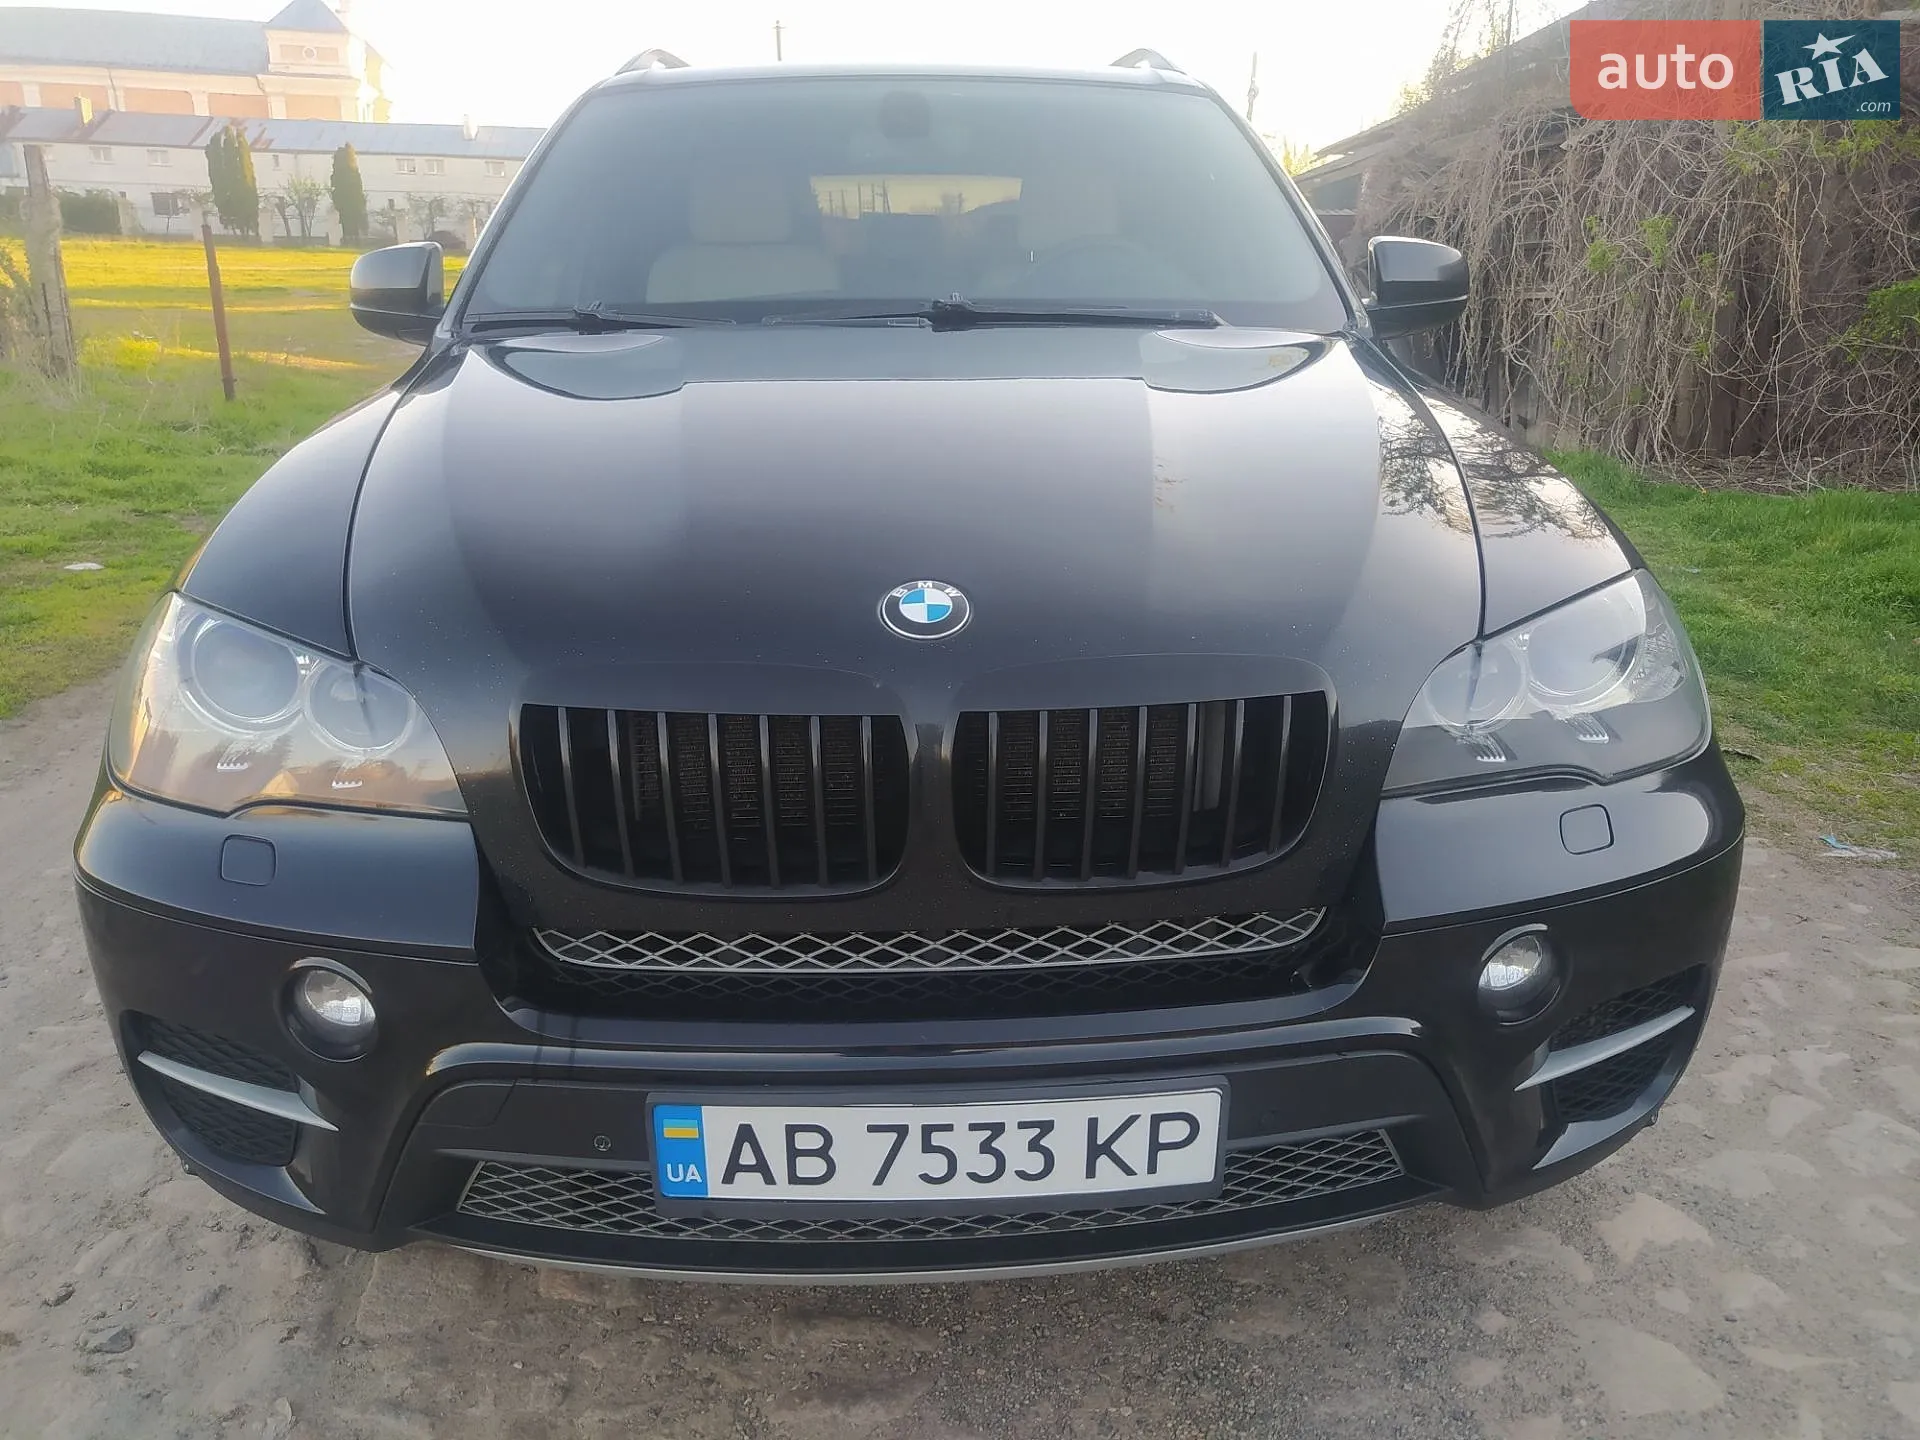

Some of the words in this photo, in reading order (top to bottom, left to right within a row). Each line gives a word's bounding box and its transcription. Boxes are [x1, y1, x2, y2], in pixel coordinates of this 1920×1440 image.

[891, 581, 961, 598] BMW
[721, 1123, 837, 1186] AB
[866, 1119, 1055, 1186] 7533
[1085, 1111, 1201, 1180] KP
[666, 1163, 702, 1184] UA
